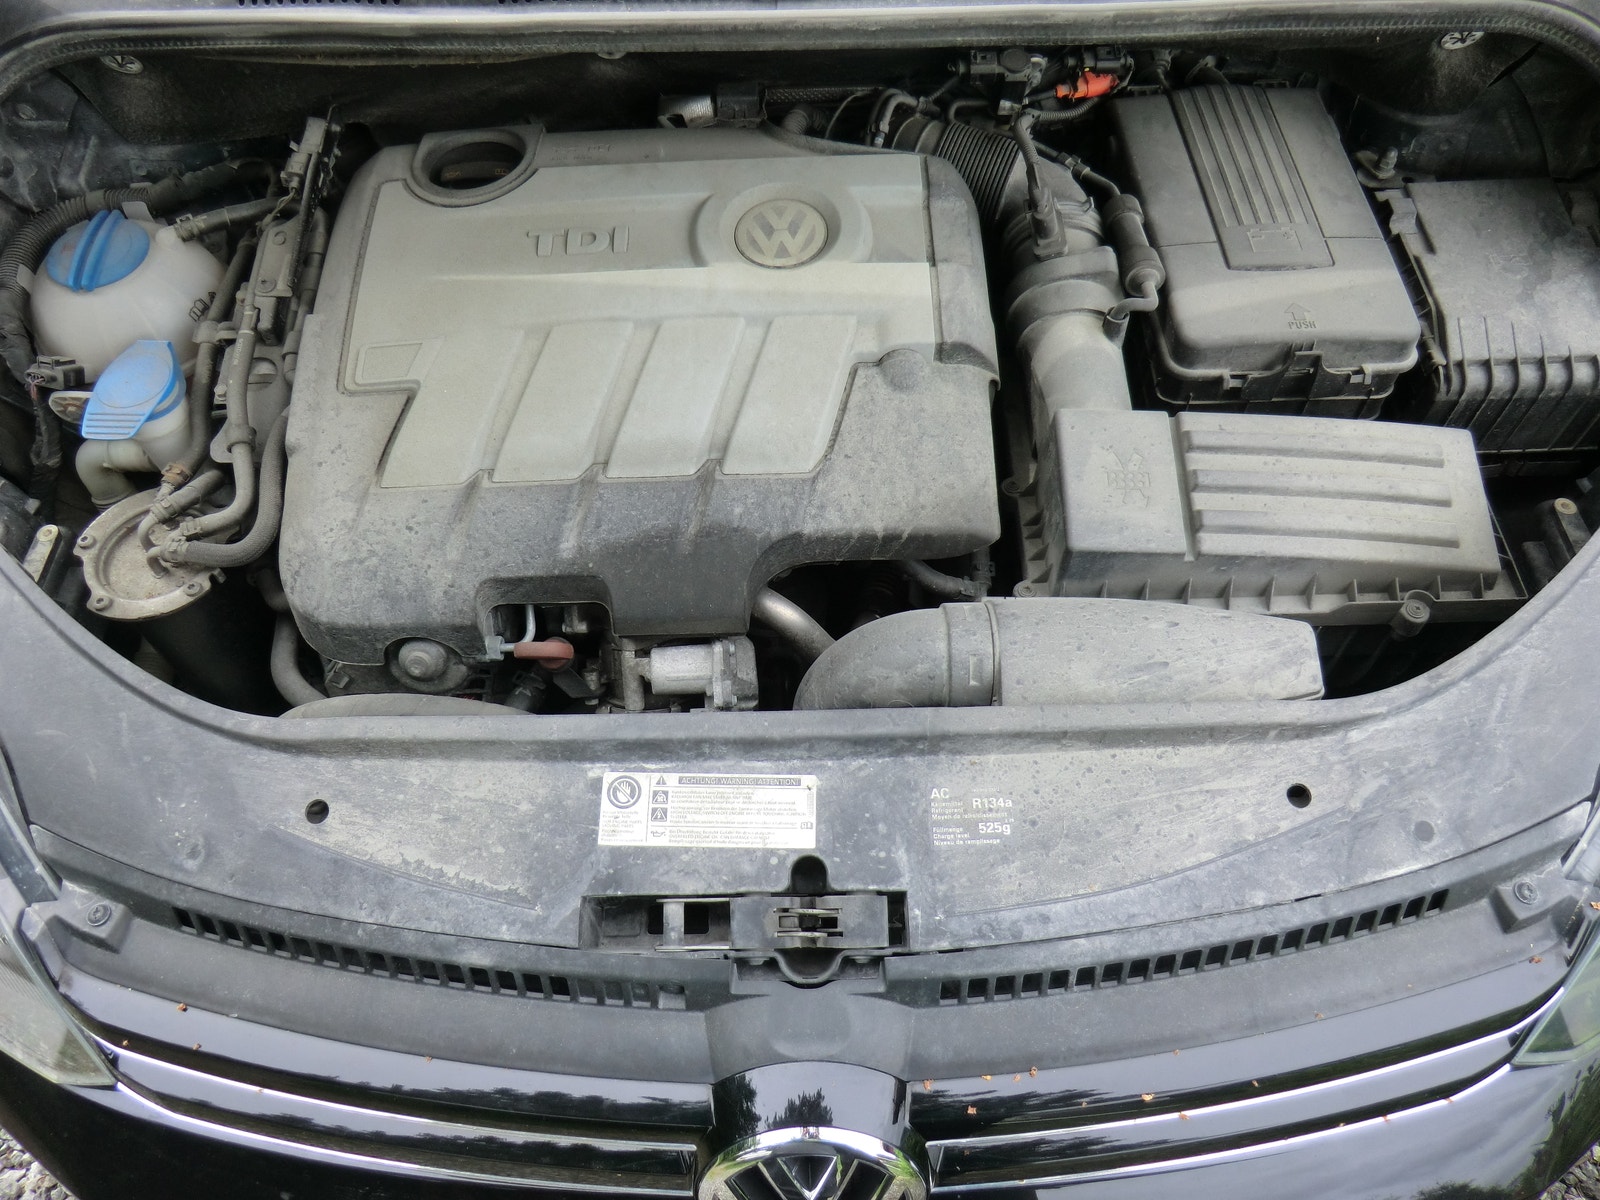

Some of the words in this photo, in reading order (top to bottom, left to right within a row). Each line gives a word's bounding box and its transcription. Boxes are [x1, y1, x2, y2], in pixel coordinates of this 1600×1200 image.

[527, 225, 630, 257] TDI
[1288, 320, 1317, 330] PUSH
[681, 777, 717, 785] ACHTUNG!
[720, 777, 757, 786] WARNING!
[758, 778, 799, 787] ATTENTION!
[931, 787, 950, 799] AC
[972, 797, 1013, 809] R134a
[978, 822, 1011, 835] 525g
